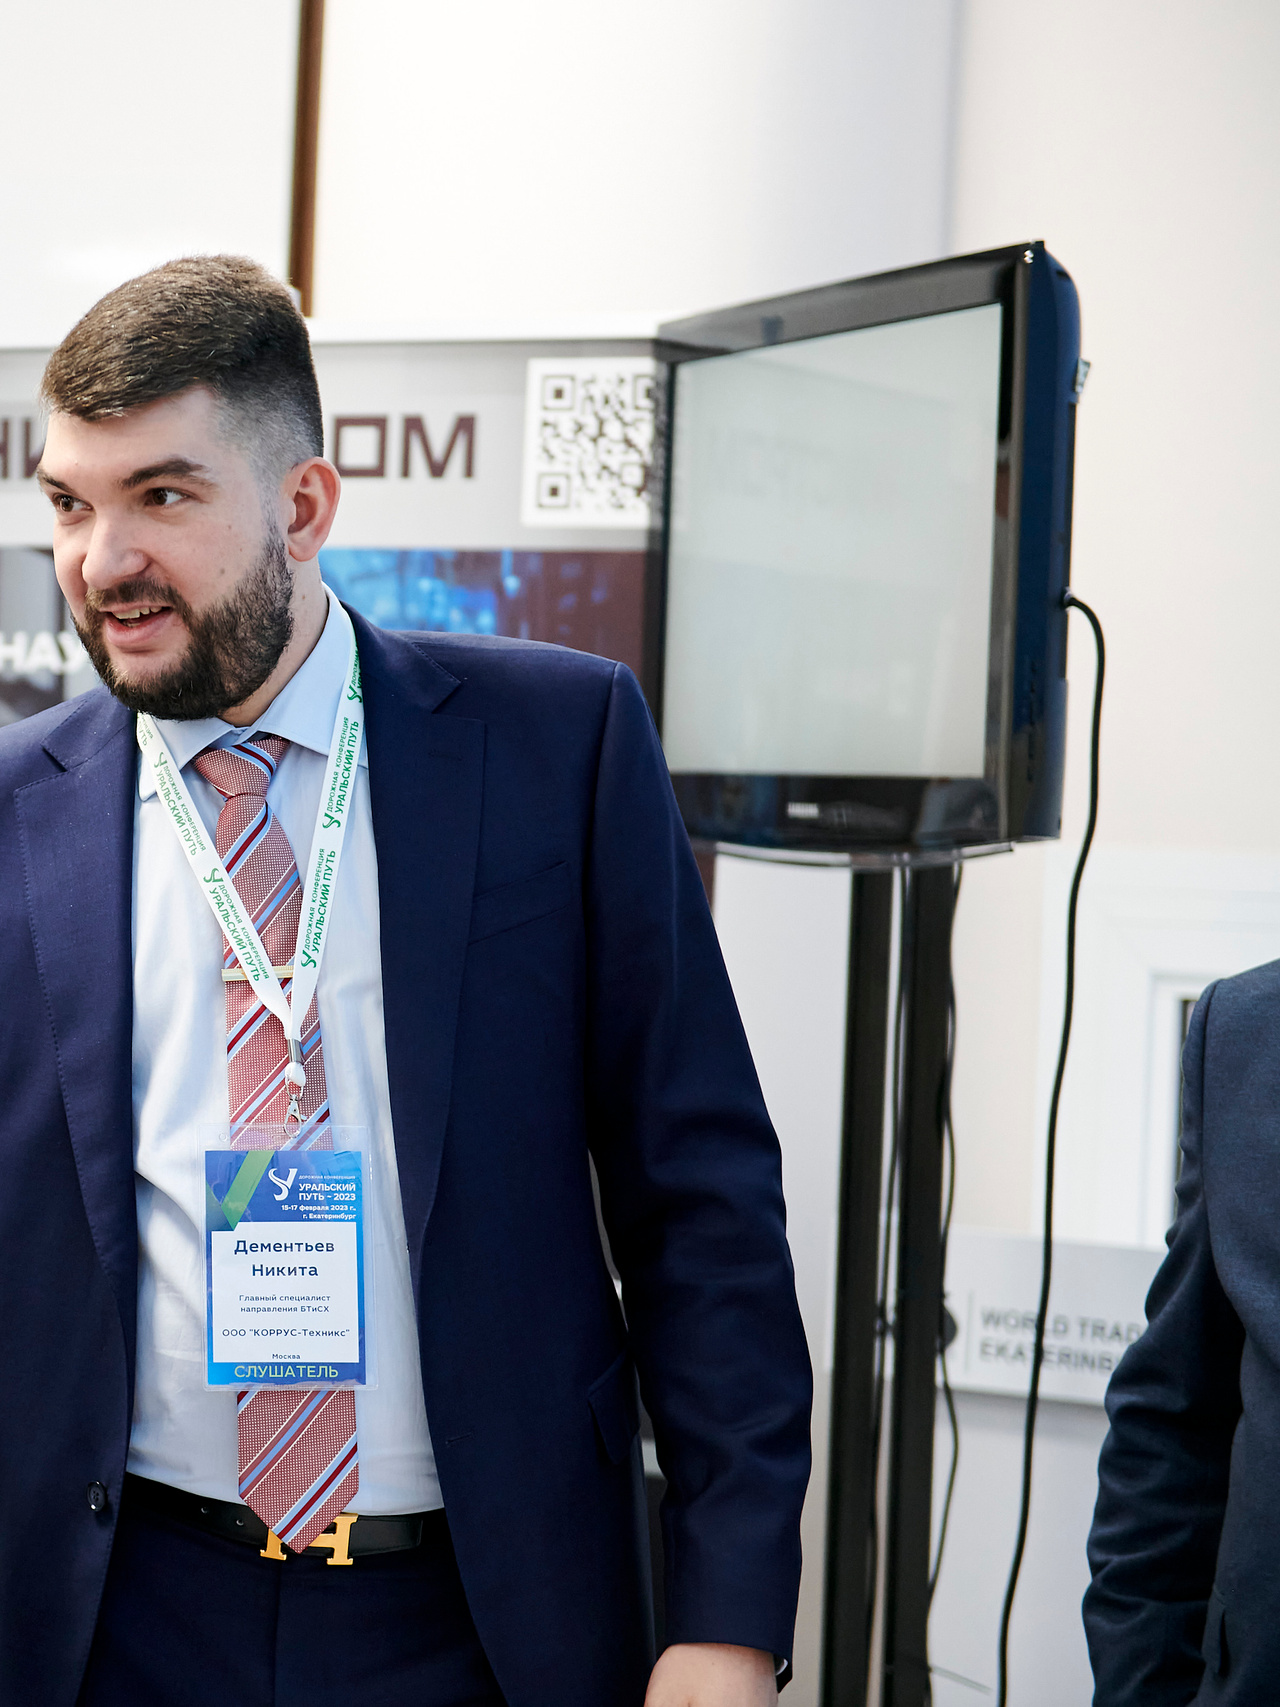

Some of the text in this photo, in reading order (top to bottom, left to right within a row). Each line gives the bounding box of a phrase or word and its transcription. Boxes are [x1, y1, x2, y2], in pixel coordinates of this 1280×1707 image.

[326, 716, 349, 813] ДОРОЖНАЯ КОНФЕРЕНЦИЯ
[335, 721, 359, 814] УРАЛЬСКИЙ ПУТЬ
[156, 769, 197, 856] УРАЛЬСКИЙ ПУТЬ
[163, 765, 206, 852] ДОРОЖНАЯ КОНФЕРЕНЦИЯ
[304, 848, 325, 950] ДОРОЖНАЯ КОНФЕРЕНЦИЯ
[311, 850, 336, 953] УРАЛЬСКИЙ ПУТЬ
[209, 887, 260, 981] УРАЛЬСКИЙ ПУТЬ
[218, 884, 270, 979] ДОРОЖНАЯ КОНФЕРЕНЦИЯ
[299, 1182, 356, 1191] УРАЛЬСКИЙ
[299, 1193, 325, 1201] ПУТЬ
[333, 1193, 356, 1201] 2023
[234, 1240, 335, 1255] Дементьев
[252, 1264, 319, 1276] Никита
[300, 1305, 330, 1313] БТиСХ
[980, 1307, 1070, 1336] WORD
[222, 1328, 350, 1337] ООО "КОРРУС-Техникс"
[979, 1338, 1114, 1370] EKAERINB
[234, 1365, 339, 1378] СЛУШАТЕЛЬ
